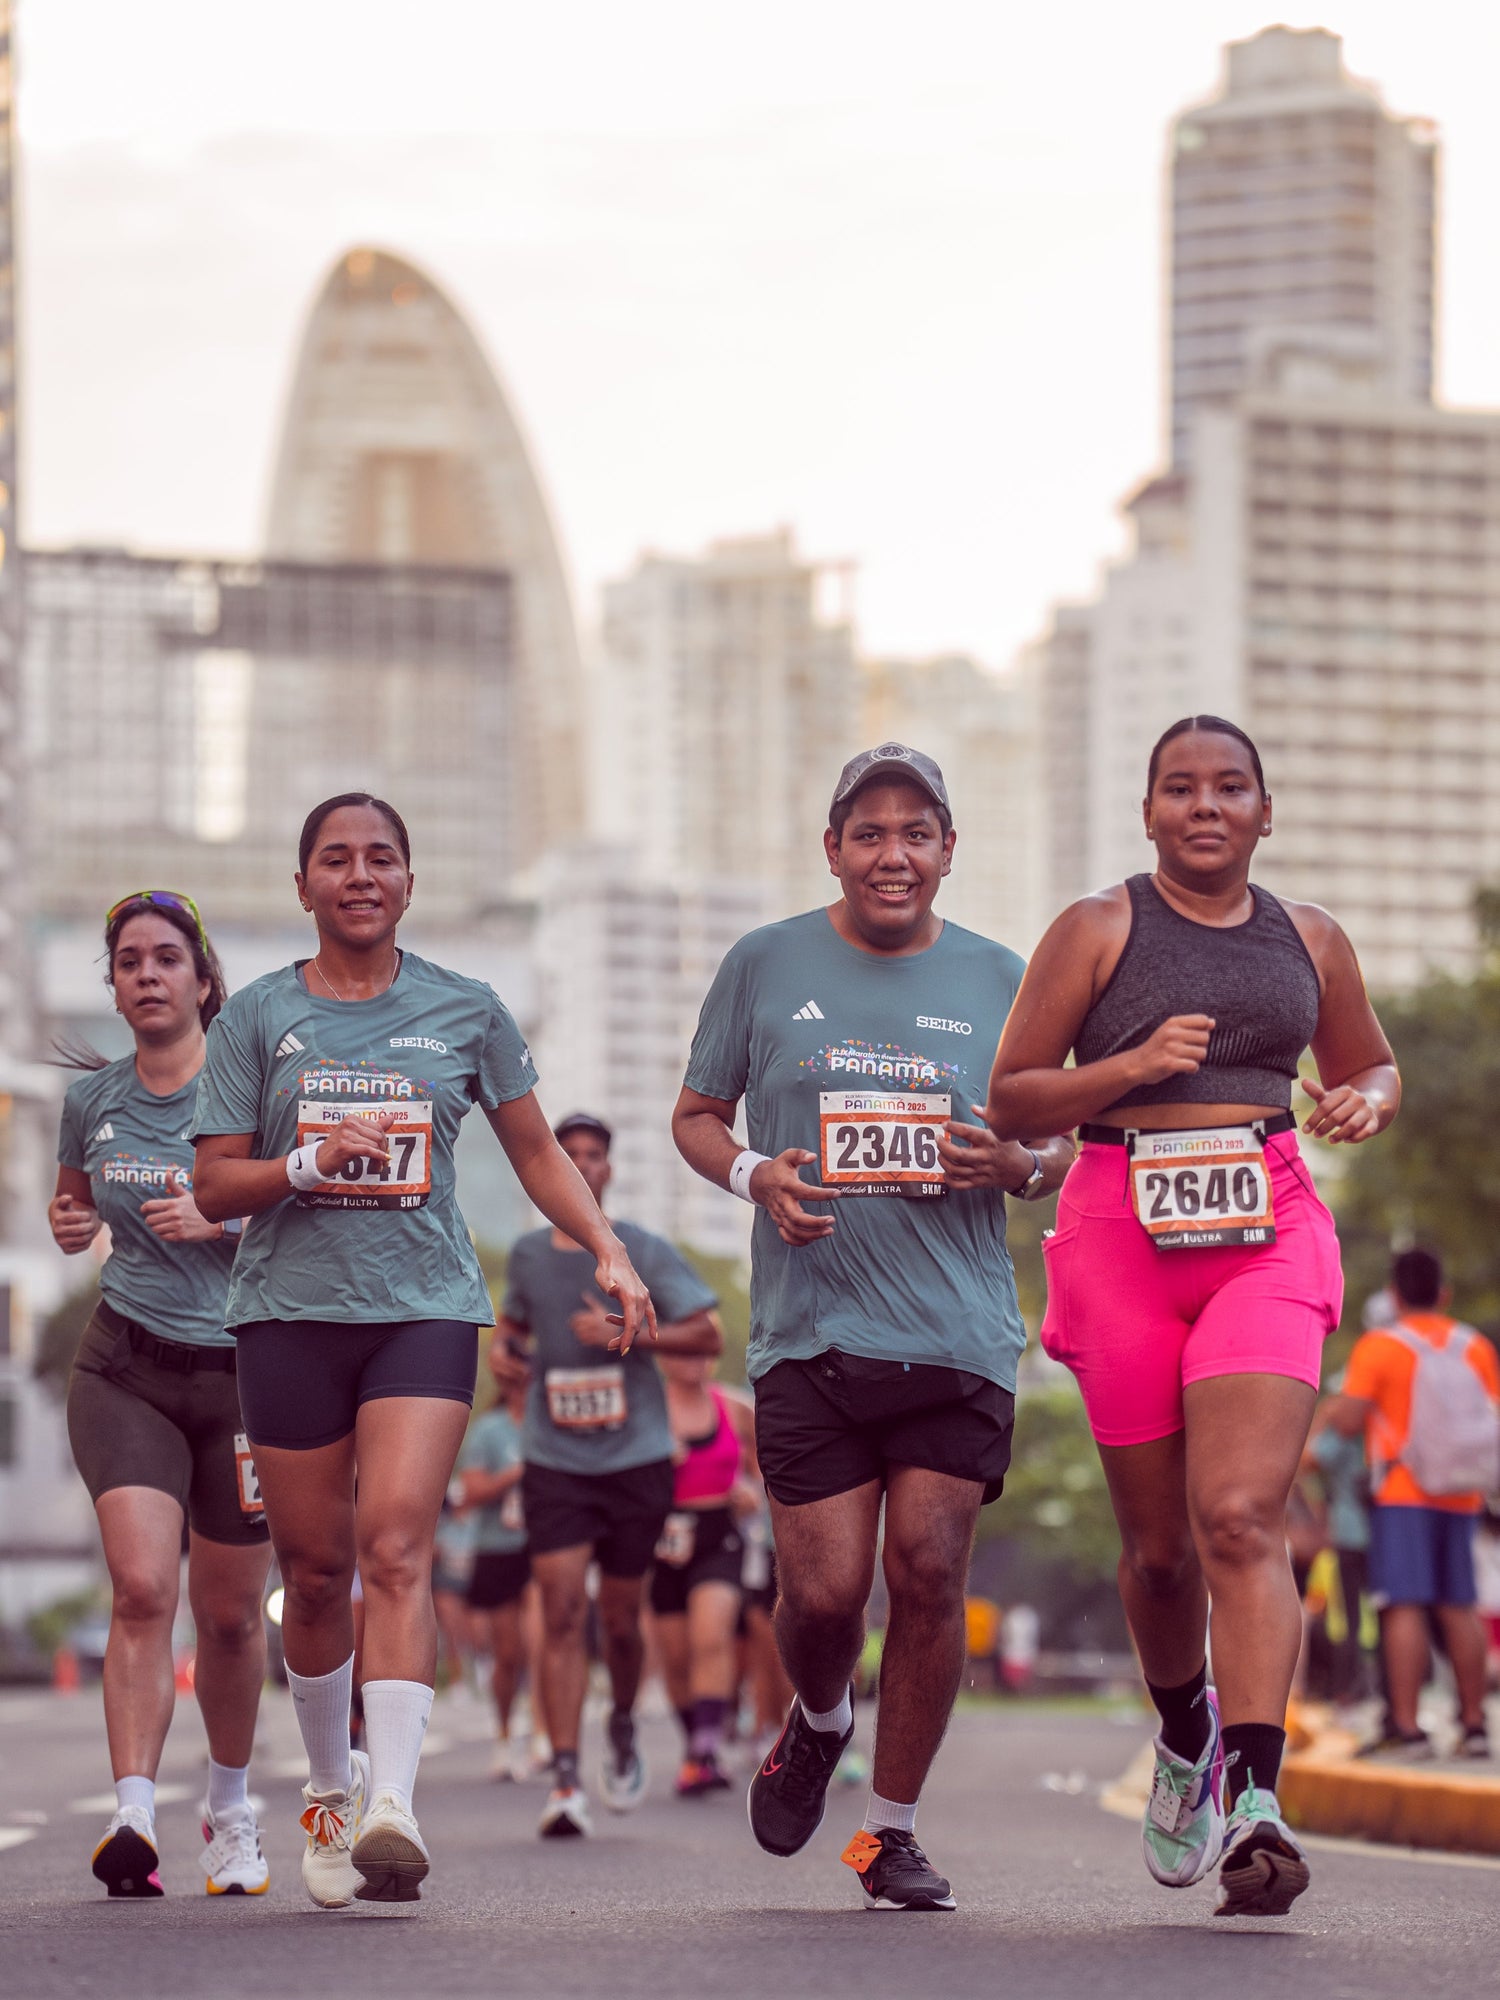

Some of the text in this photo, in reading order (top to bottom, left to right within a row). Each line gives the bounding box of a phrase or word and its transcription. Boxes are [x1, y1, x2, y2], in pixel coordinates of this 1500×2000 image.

[916, 1015, 972, 1036] SEIKO
[389, 1037, 447, 1054] SEIKO
[849, 1050, 880, 1059] Maratón
[321, 1069, 355, 1077] Maratón
[831, 1056, 935, 1080] PANAMÁ
[304, 1077, 412, 1097] PANAMÁ
[845, 1098, 927, 1111] PANAMÁ 2025
[836, 1125, 937, 1169] 2346
[1153, 1138, 1222, 1155] PANAMÁ
[1225, 1140, 1244, 1150] 2025
[873, 1185, 902, 1193] ULTRA
[922, 1184, 941, 1195] 5KM
[1146, 1166, 1258, 1219] 2640
[349, 1199, 379, 1207] ULTRA
[400, 1196, 421, 1208] 5KM
[1190, 1233, 1221, 1243] ULTRA
[1243, 1228, 1265, 1242] 5KM
